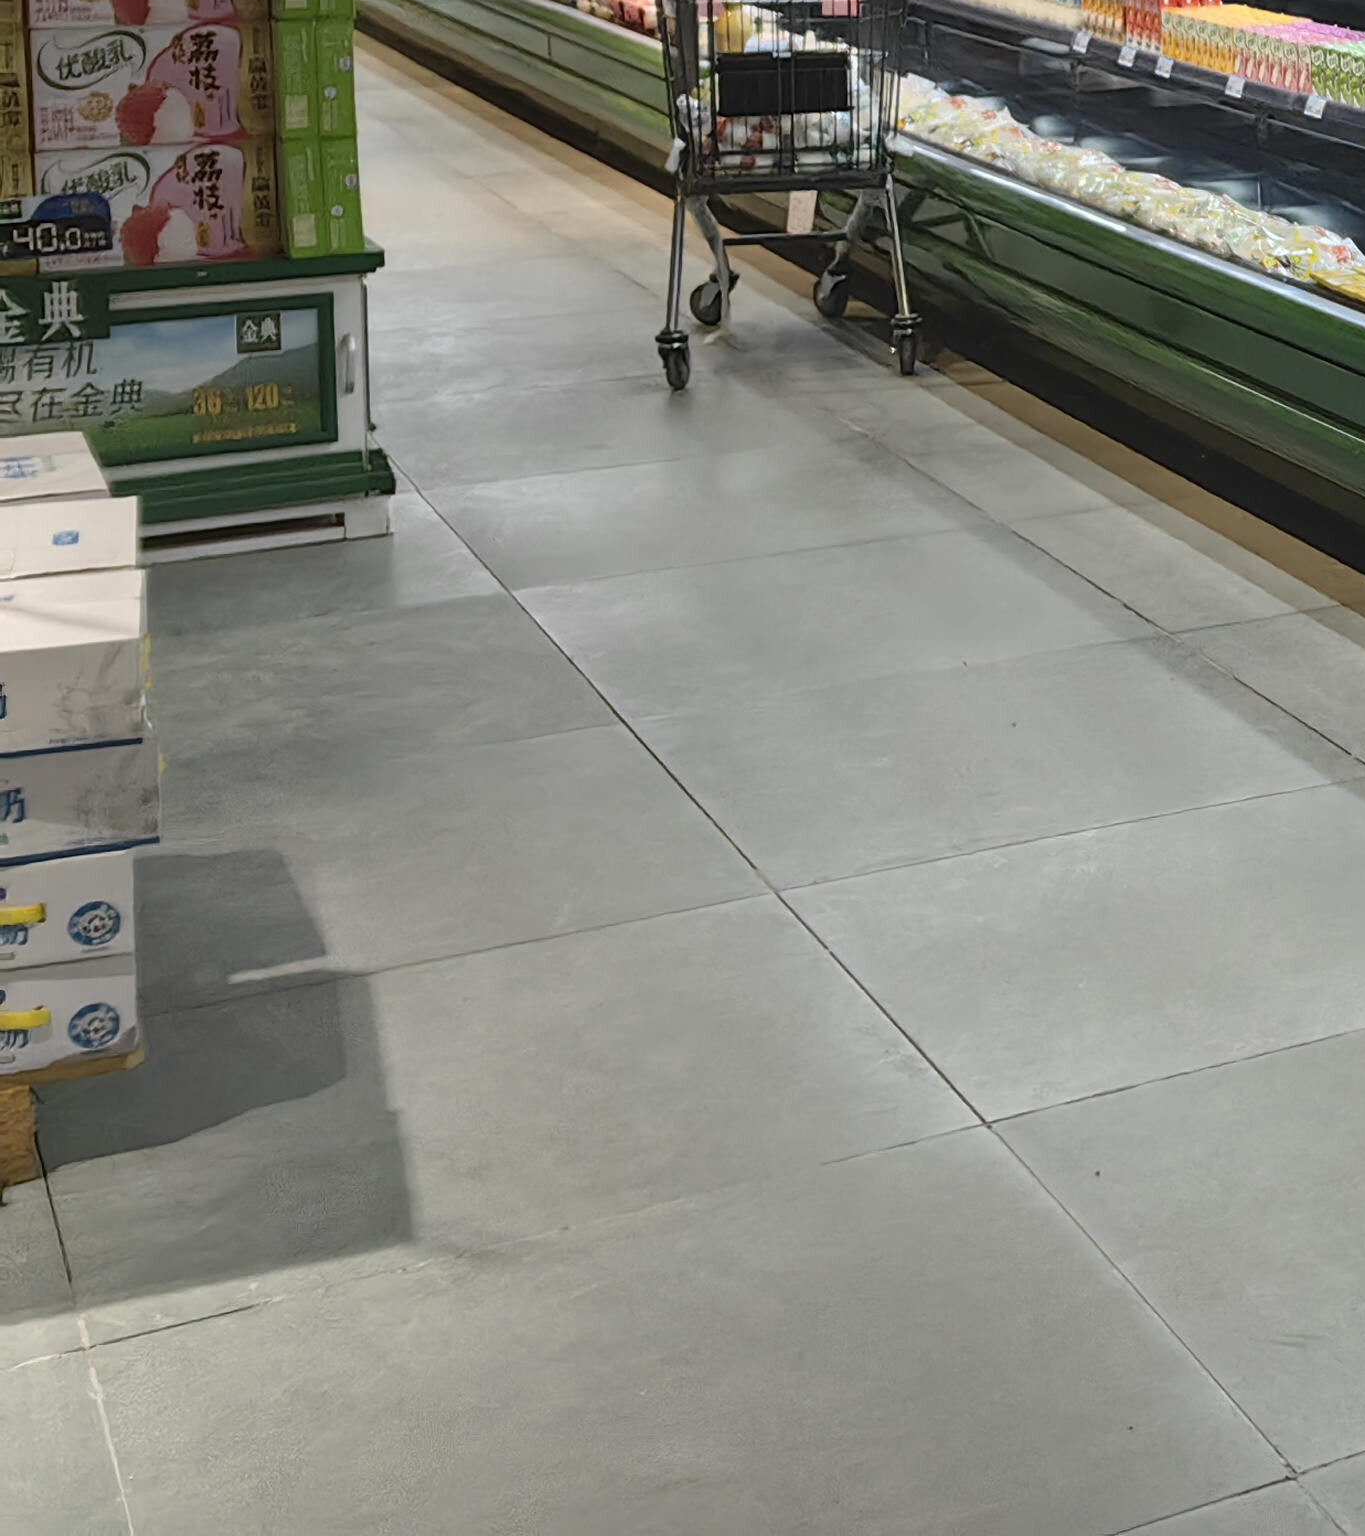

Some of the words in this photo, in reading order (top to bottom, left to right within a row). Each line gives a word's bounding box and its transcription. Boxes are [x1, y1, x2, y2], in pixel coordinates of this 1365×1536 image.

[55, 38, 134, 80] 优酸乳
[188, 31, 221, 91] 荔枝
[192, 150, 224, 211] 荔枝
[13, 222, 81, 253] 40.0
[242, 316, 278, 343] 金典
